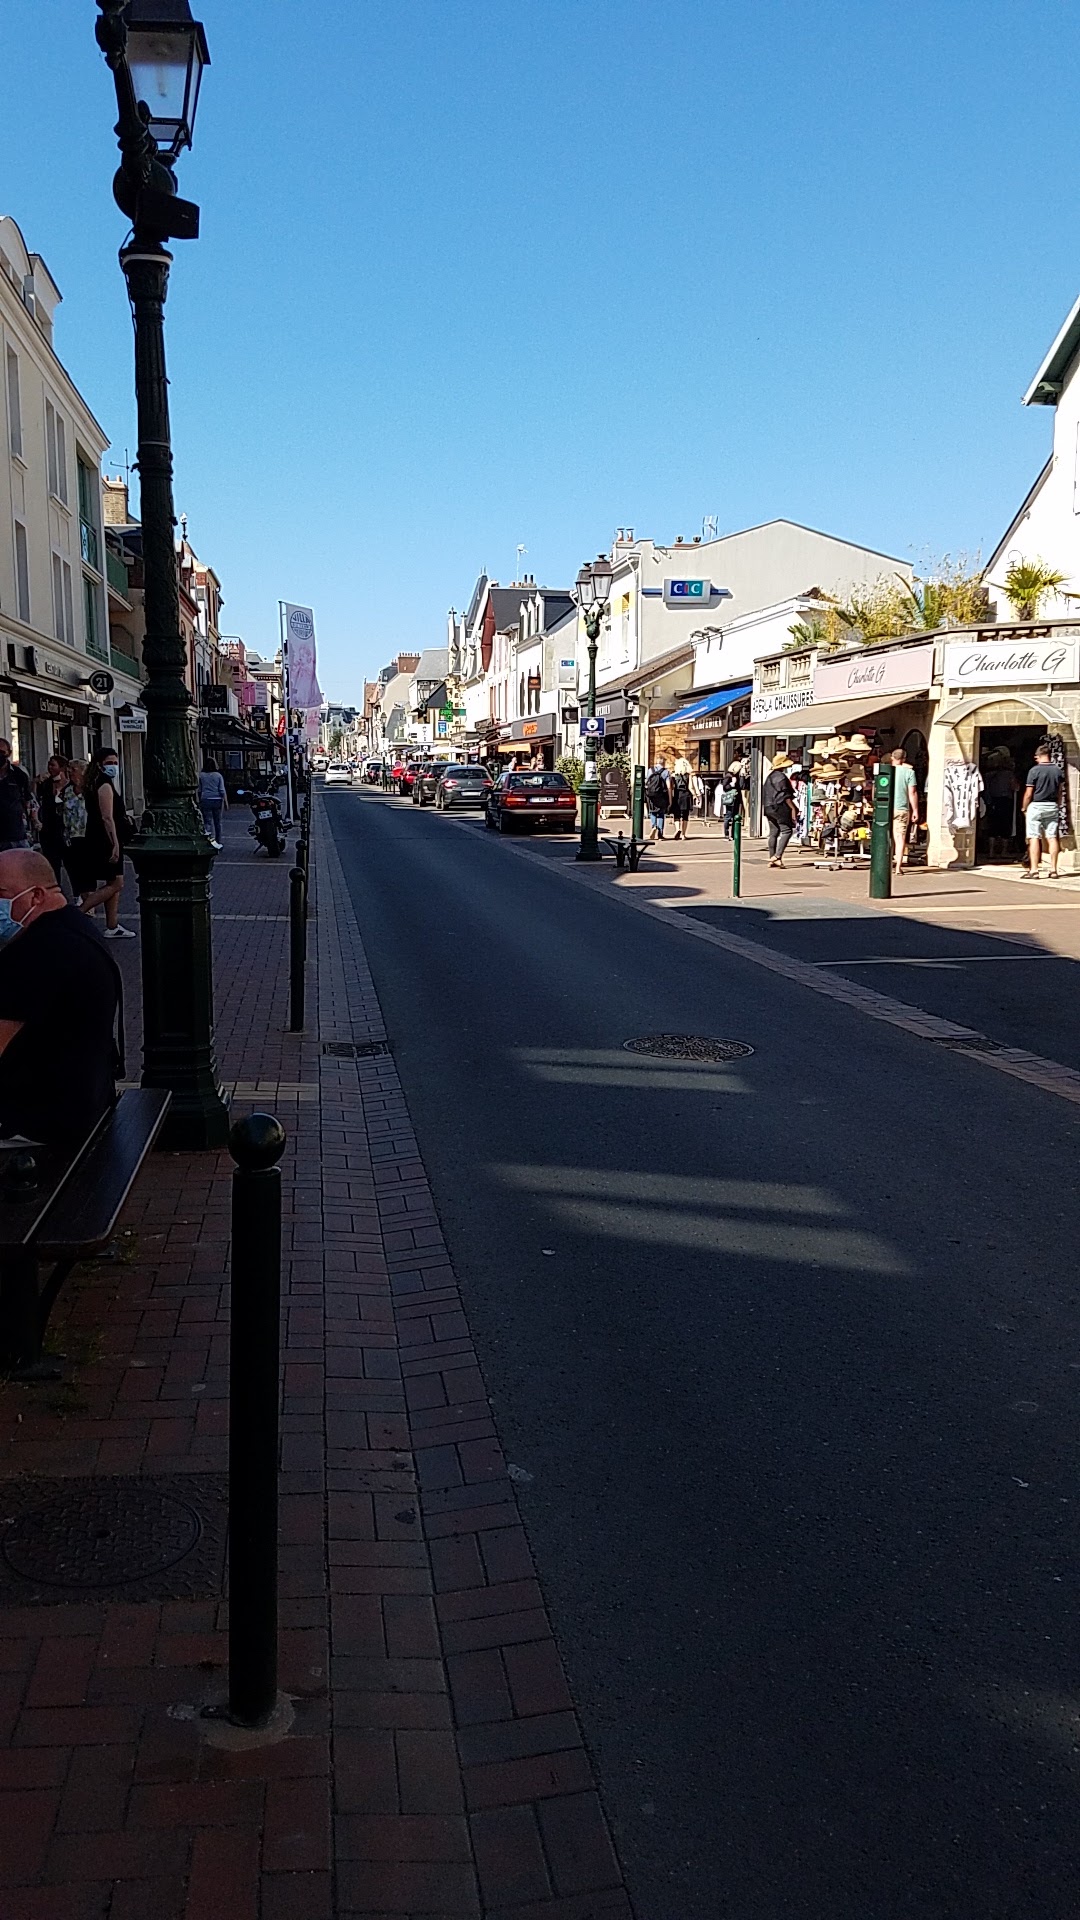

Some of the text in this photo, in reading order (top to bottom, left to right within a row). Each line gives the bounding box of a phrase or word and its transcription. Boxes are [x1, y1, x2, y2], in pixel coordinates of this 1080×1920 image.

[673, 582, 700, 594] CIC
[958, 648, 1067, 676] Charlotte G
[95, 677, 108, 688] 21
[848, 662, 886, 688] Charlotte G
[774, 690, 814, 711] CHAUSSURES
